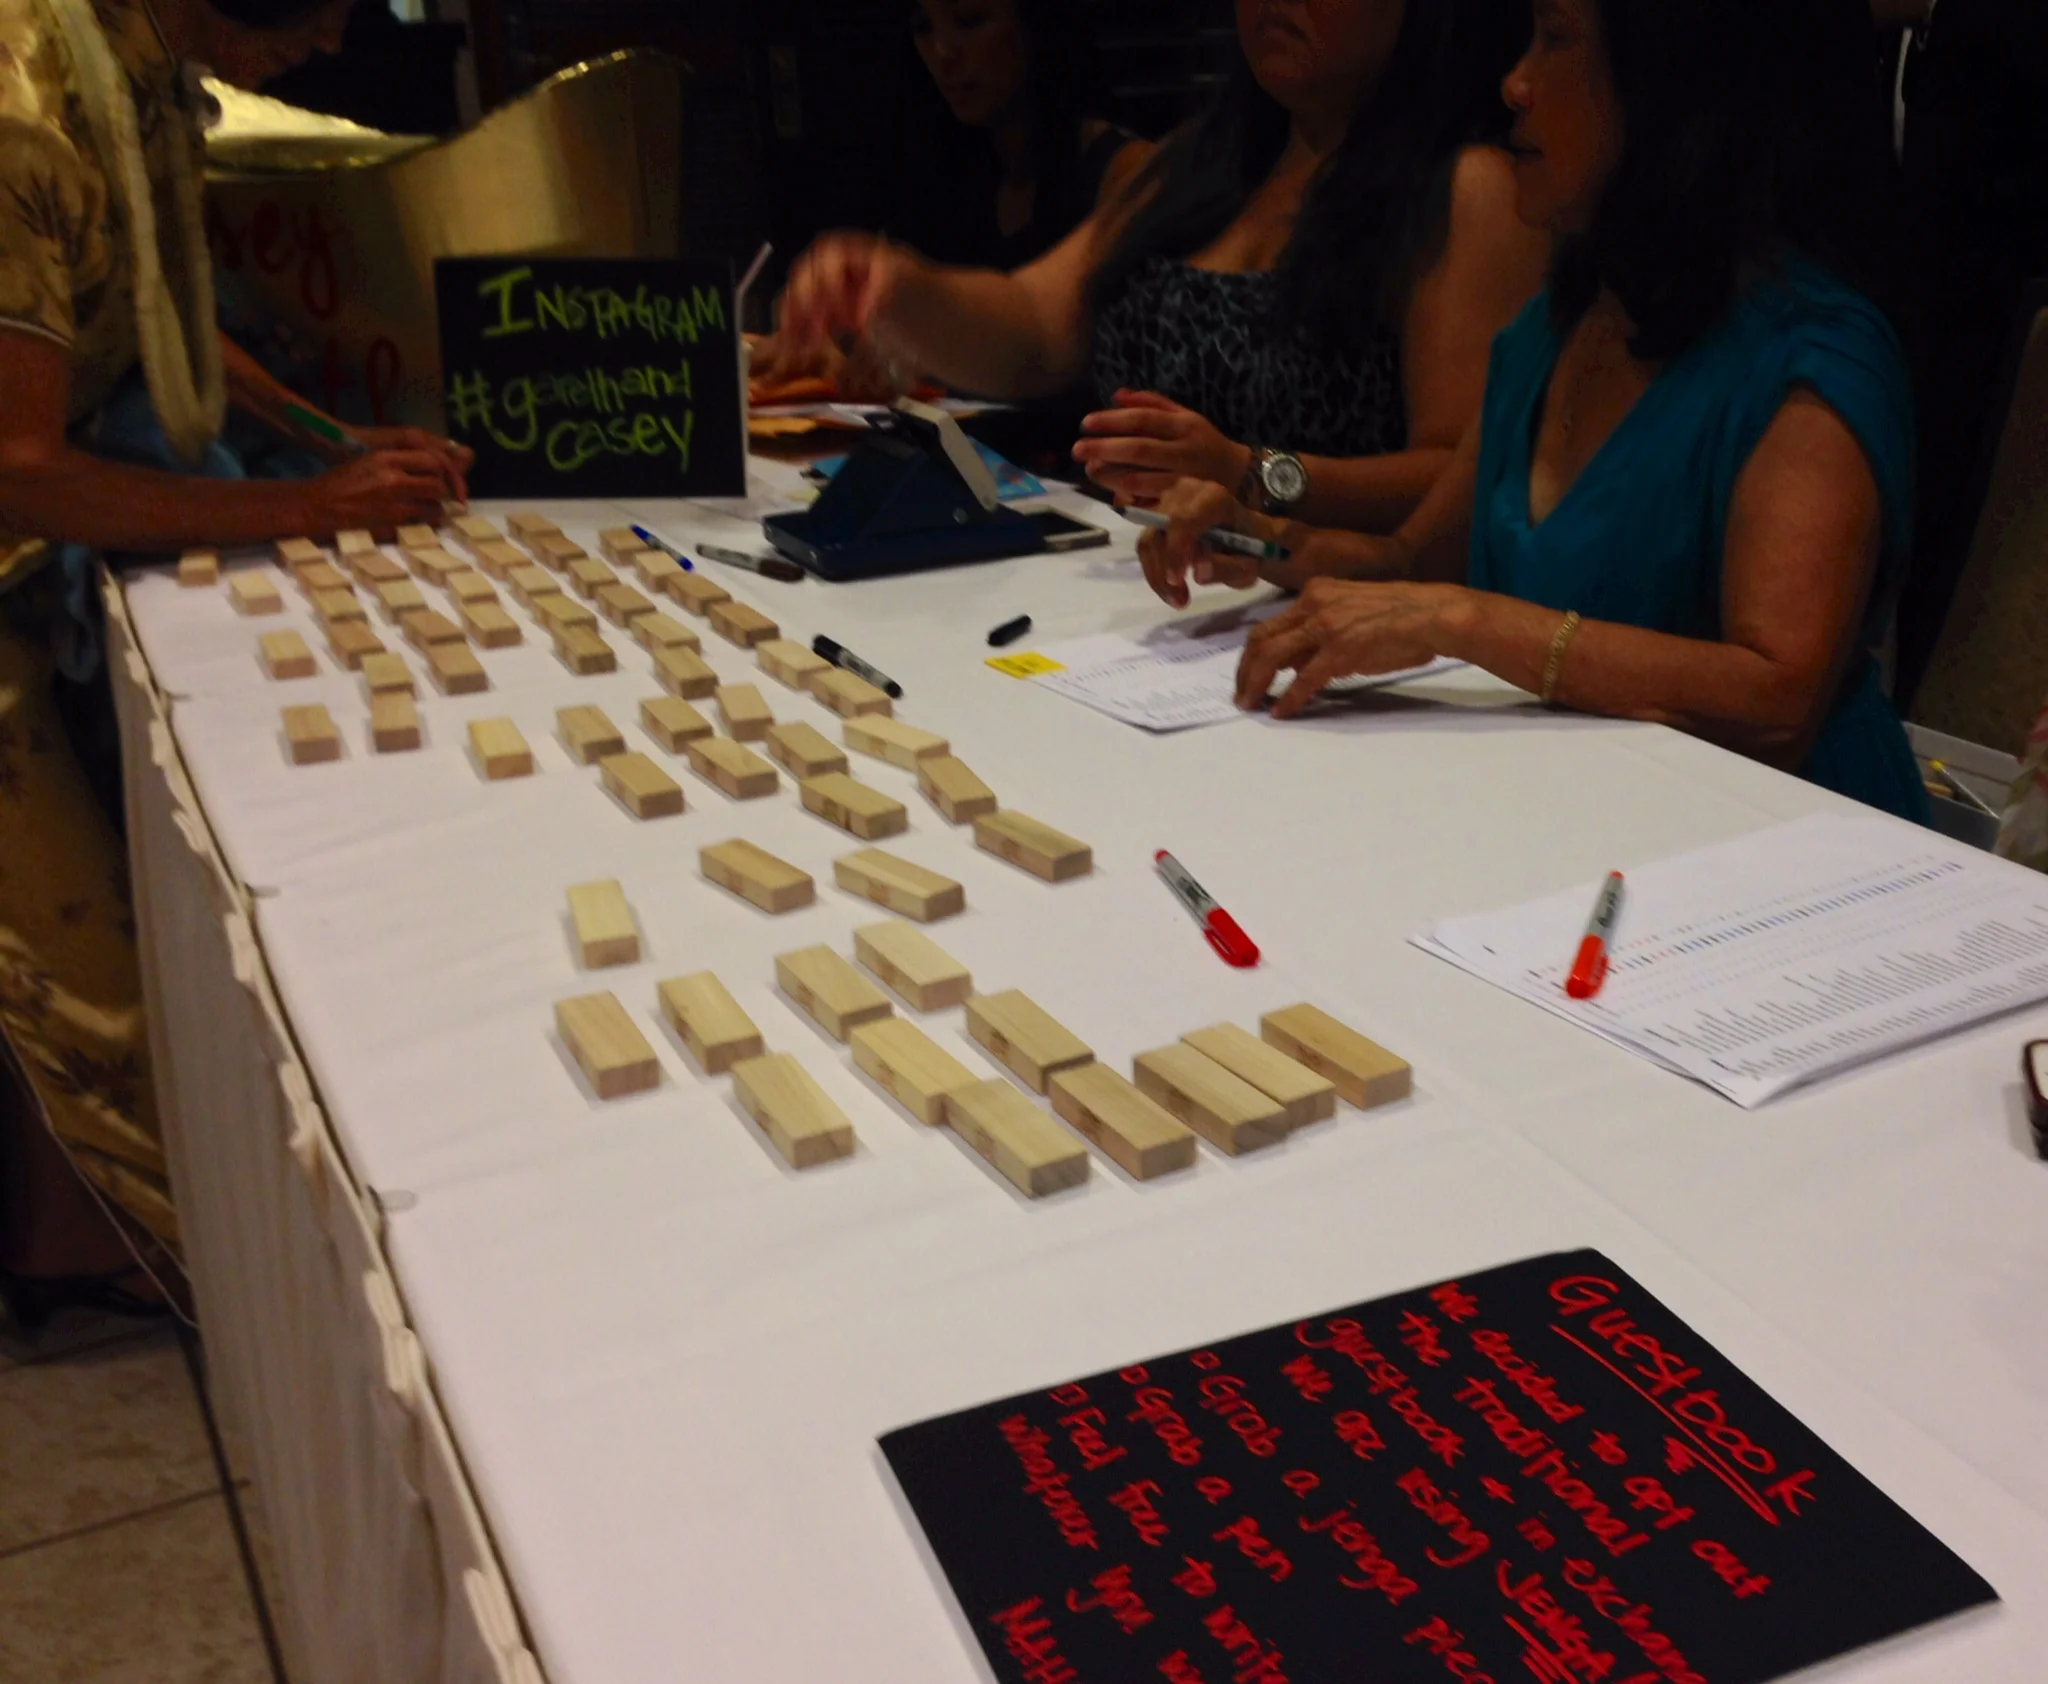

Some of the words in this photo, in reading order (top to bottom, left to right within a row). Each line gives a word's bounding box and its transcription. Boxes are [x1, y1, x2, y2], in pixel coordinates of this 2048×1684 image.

[478, 266, 727, 345] INSTAGRAM
[1125, 1386, 1203, 1466] Grab
[1198, 1374, 1283, 1458] Grab
[1293, 1316, 1466, 1468] guestbook
[1515, 1510, 1557, 1552] in
[1397, 1308, 1451, 1368] the
[1453, 1375, 1652, 1558] traditional
[1548, 1275, 1817, 1516] Guestbook
[1058, 1406, 1129, 1471] Feel
[1171, 1555, 1218, 1598] to
[1195, 1475, 1234, 1505] a
[1282, 1468, 1321, 1499] a
[1469, 1329, 1585, 1424] decided
[1589, 1429, 1629, 1465] to
[1623, 1475, 1696, 1531] opt
[1690, 1538, 1772, 1599] out
[1212, 1515, 1294, 1583] pen
[1298, 1500, 1420, 1606] jenga
[1396, 1467, 1492, 1568] using
[1064, 1563, 1156, 1636] you
